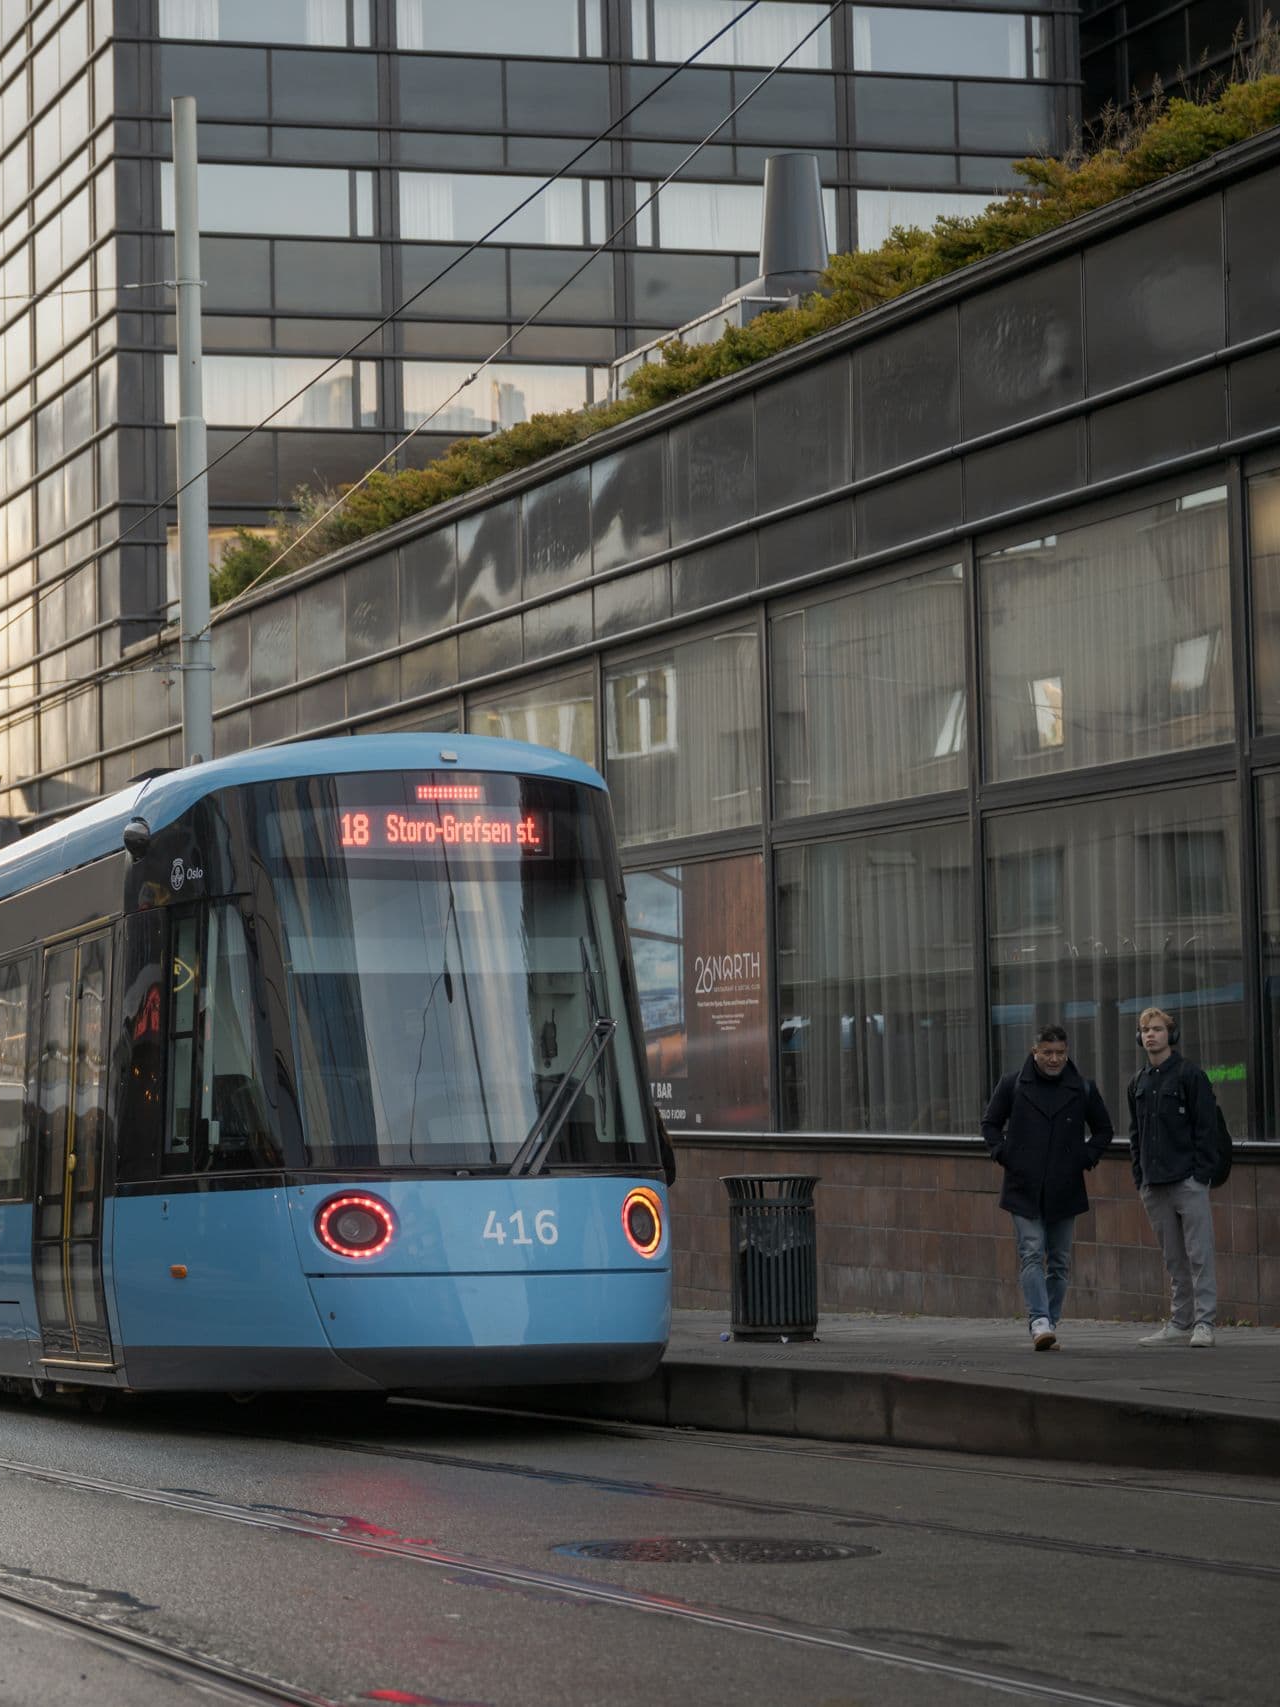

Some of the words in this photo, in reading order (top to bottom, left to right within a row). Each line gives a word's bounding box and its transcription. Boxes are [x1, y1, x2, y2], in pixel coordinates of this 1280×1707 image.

[341, 813, 369, 845] 18
[387, 814, 512, 844] Storo-Grefsen
[516, 817, 540, 844] st.
[186, 867, 203, 880] Oslo
[656, 1082, 672, 1099] BAR
[483, 1209, 558, 1245] 416
